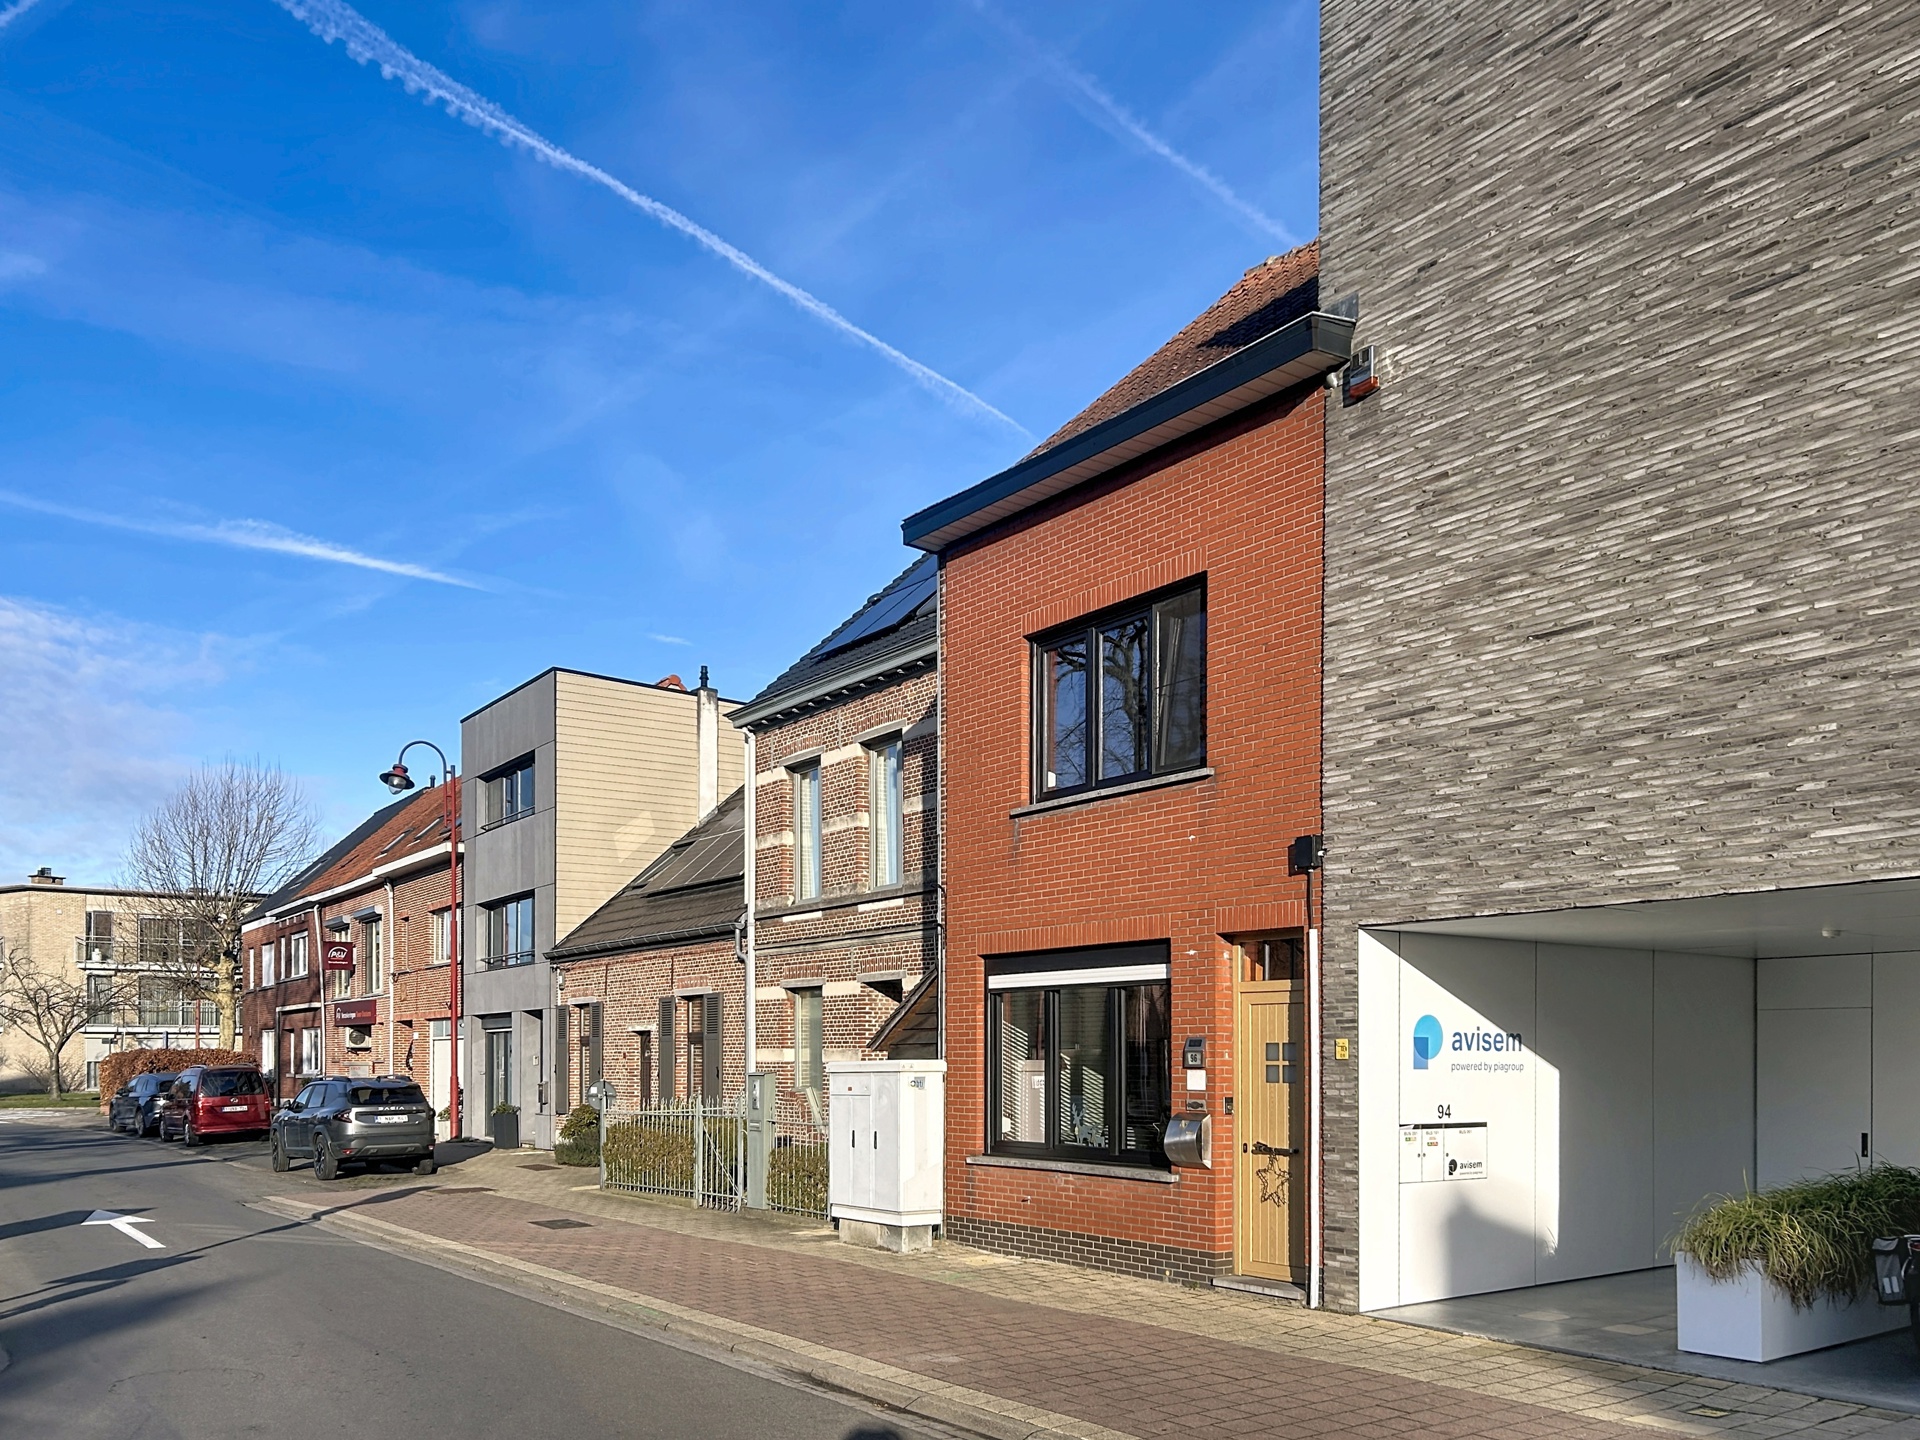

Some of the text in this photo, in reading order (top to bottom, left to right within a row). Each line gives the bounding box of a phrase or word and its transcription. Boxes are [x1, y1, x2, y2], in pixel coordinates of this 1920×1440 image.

[1451, 1026, 1522, 1052] avisem
[1451, 1062, 1524, 1073] powered by piagroup
[1437, 1104, 1452, 1119] 94
[1459, 1161, 1483, 1169] avisem
